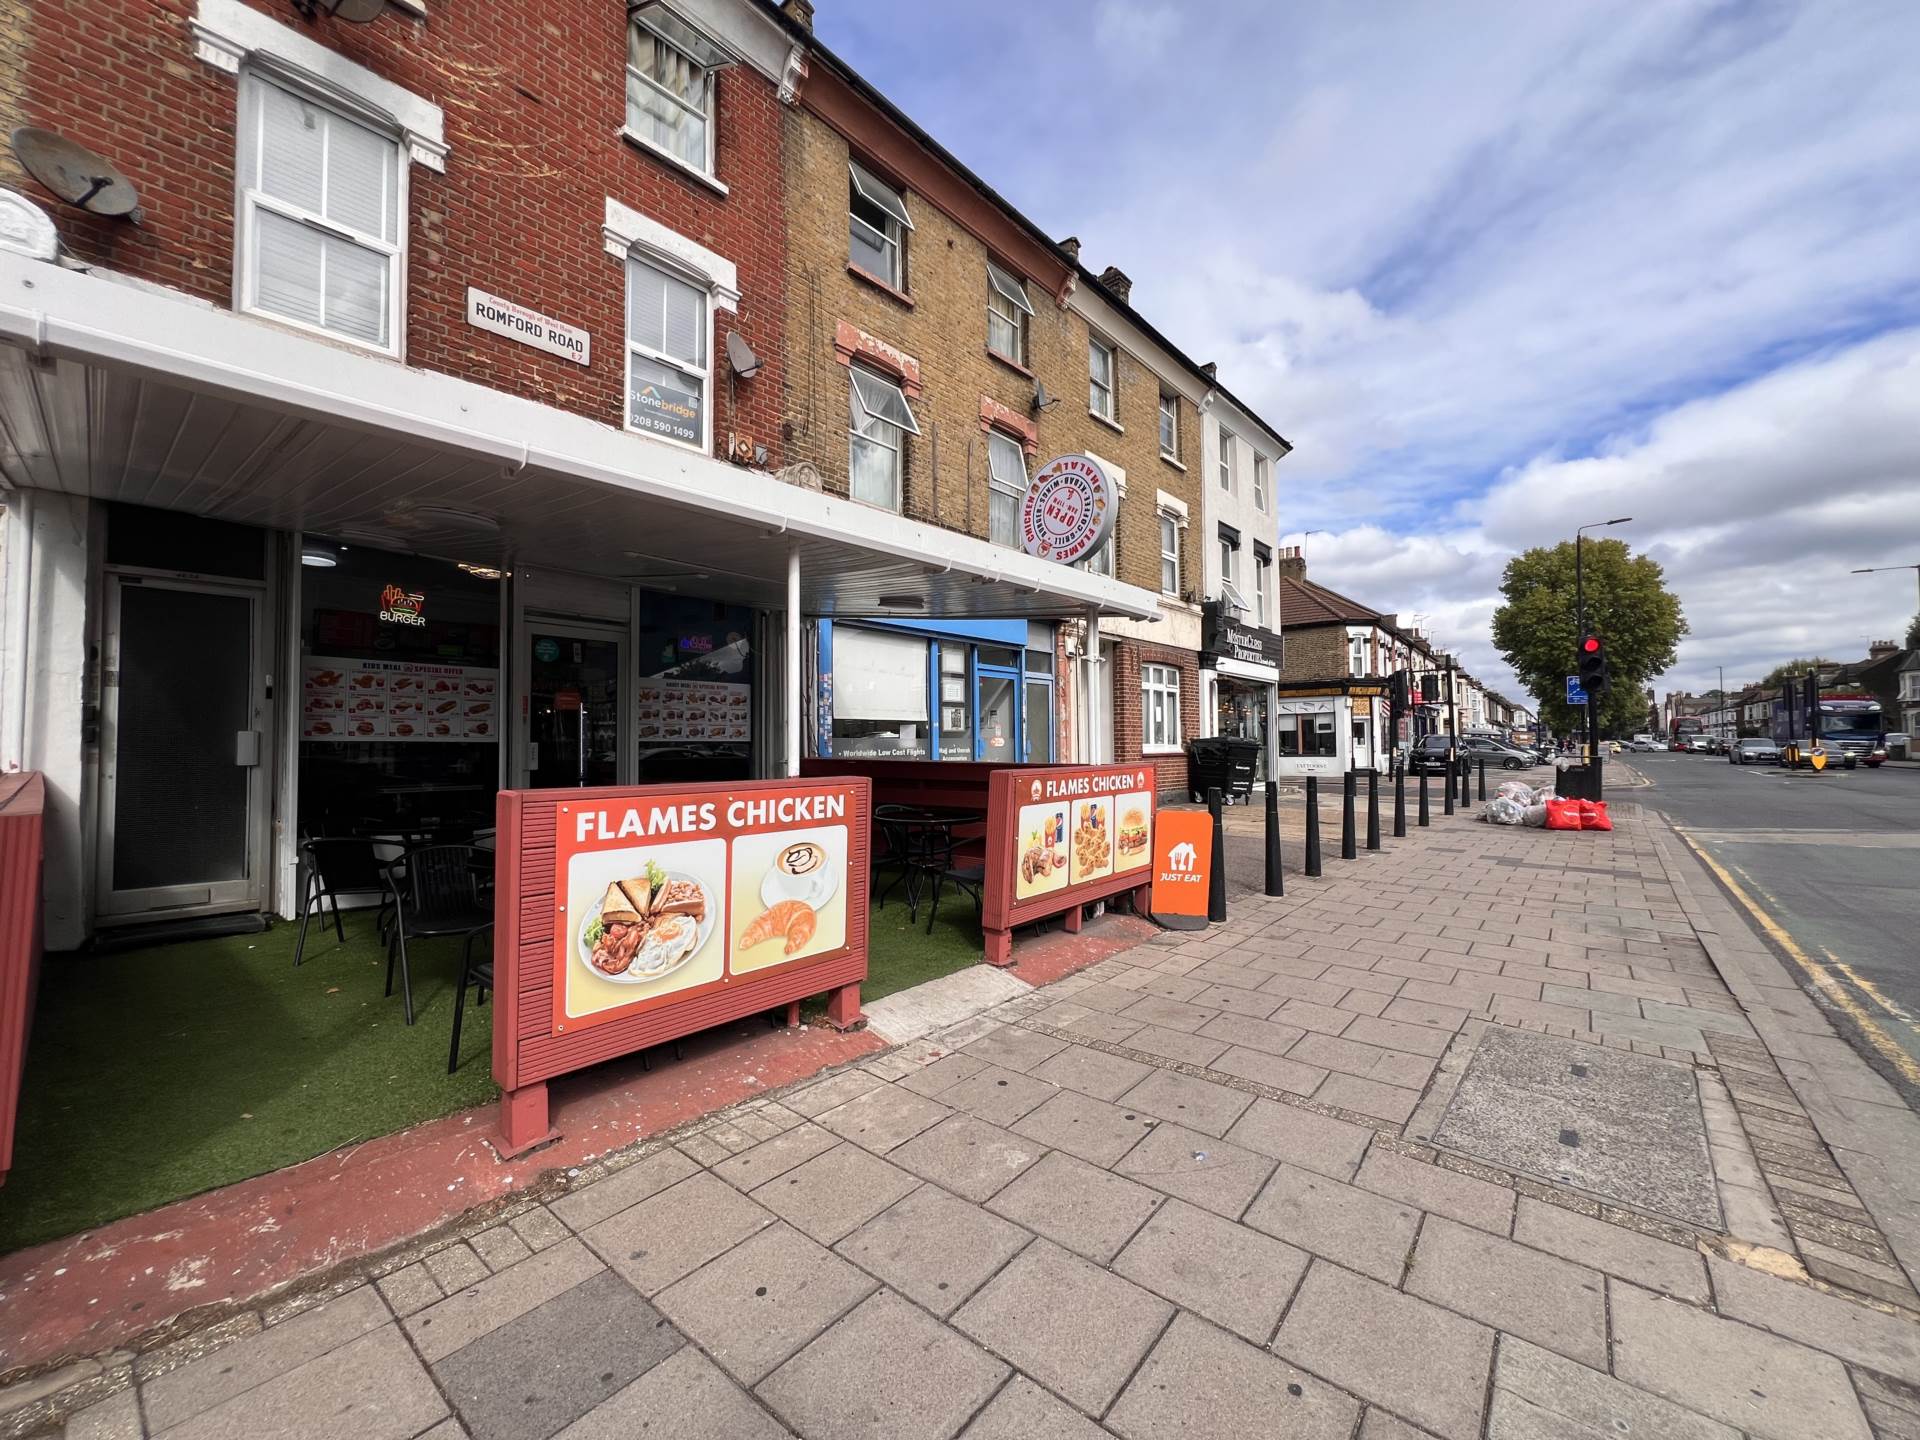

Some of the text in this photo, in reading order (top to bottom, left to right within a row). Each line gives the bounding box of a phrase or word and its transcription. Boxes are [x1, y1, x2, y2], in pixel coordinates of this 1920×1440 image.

[476, 302, 583, 353] ROMFORD ROAD
[653, 420, 671, 433] 590
[673, 426, 694, 439] 1499
[1063, 461, 1100, 483] HALAL
[1040, 479, 1060, 503] WINGS
[1077, 496, 1091, 530] COFFEE
[1046, 504, 1075, 527] OPEN
[1024, 496, 1096, 560] FLAMES CHICKEN
[380, 611, 426, 626] BURGER
[843, 749, 877, 757] Worldwide
[878, 749, 891, 757] Low
[906, 748, 925, 757] Flights
[1046, 774, 1134, 798] FLAMES CHICKEN
[576, 794, 845, 842] FLAMES CHICKEN
[1160, 873, 1203, 882] JUST EAT
